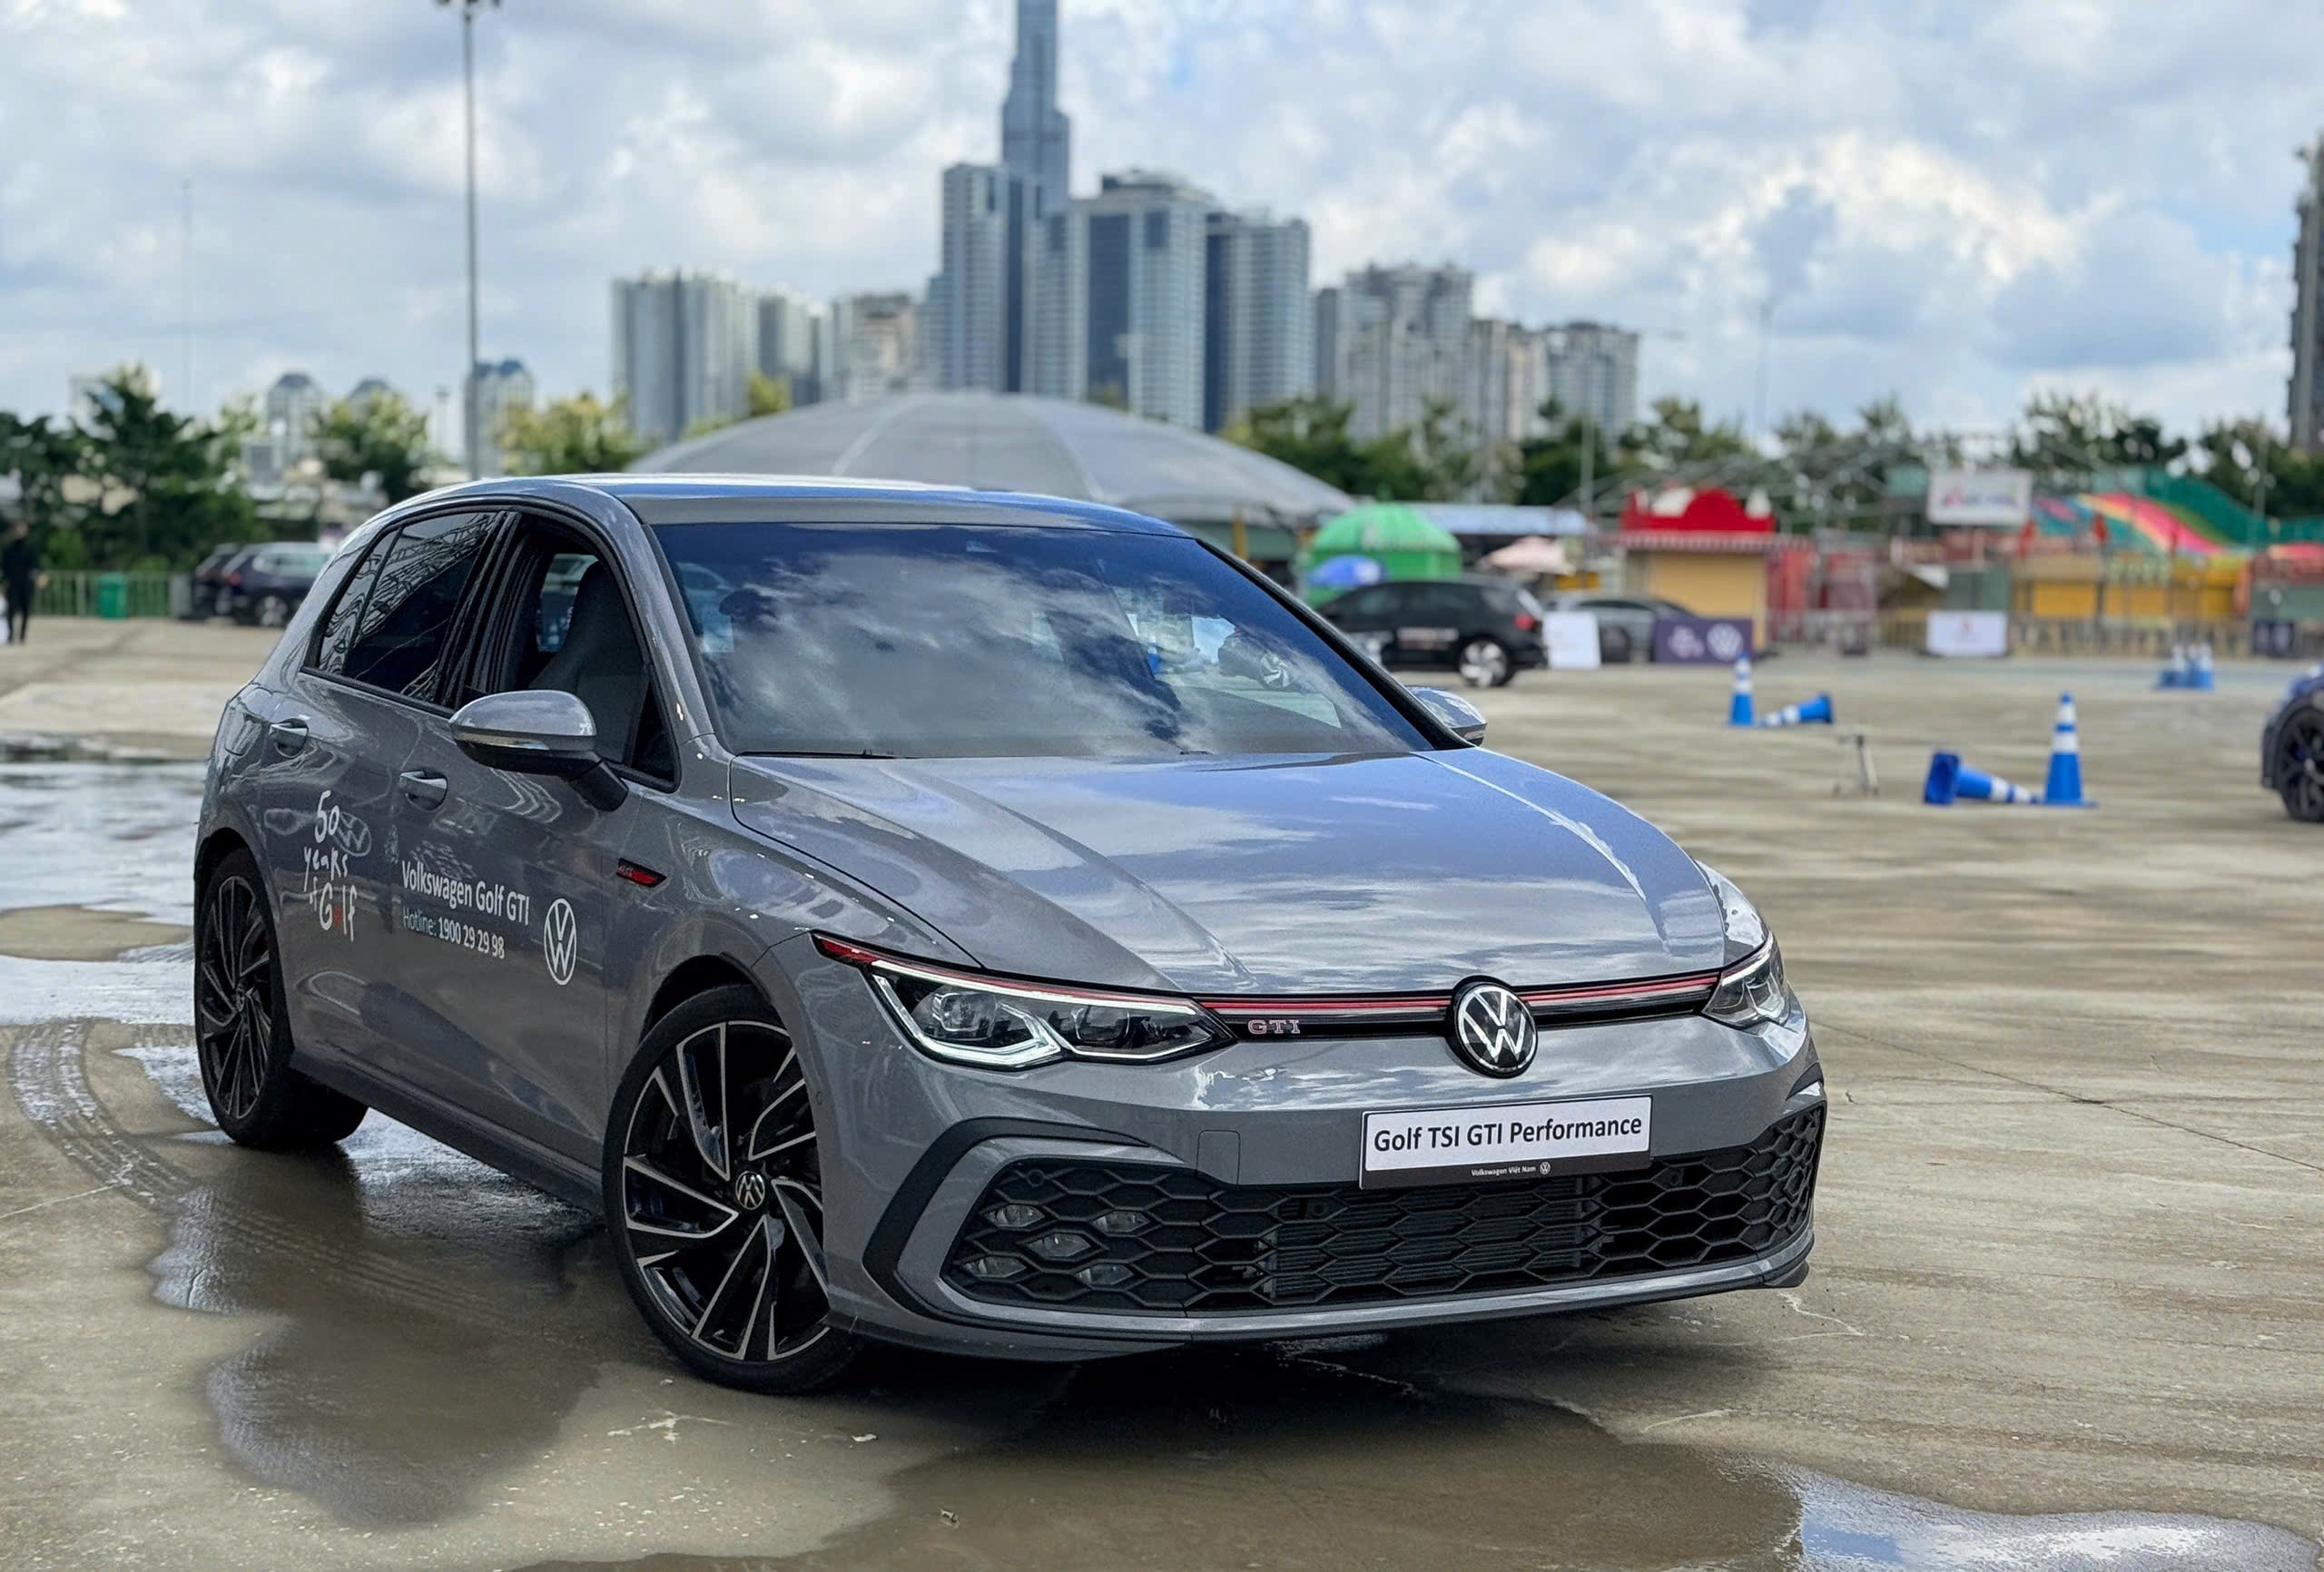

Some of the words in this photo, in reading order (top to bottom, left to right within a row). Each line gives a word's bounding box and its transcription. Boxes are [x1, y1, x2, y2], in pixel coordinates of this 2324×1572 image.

[314, 790, 340, 843] 50
[320, 882, 358, 942] Golf
[402, 860, 472, 909] Volkswagen
[476, 880, 505, 917] Golf
[507, 891, 530, 926] GTI
[402, 907, 437, 937] Hotline:
[438, 917, 461, 945] 1900
[463, 924, 476, 949] 29
[478, 929, 490, 954] 29
[491, 934, 505, 959] 98
[1248, 1019, 1301, 1035] GTI
[1456, 987, 1537, 1070] VW
[1374, 1125, 1423, 1151] Golf
[1428, 1125, 1460, 1148] TSI
[1466, 1123, 1503, 1145] GTI
[1510, 1117, 1642, 1144] Performance
[1471, 1168, 1507, 1176] Volkswagen
